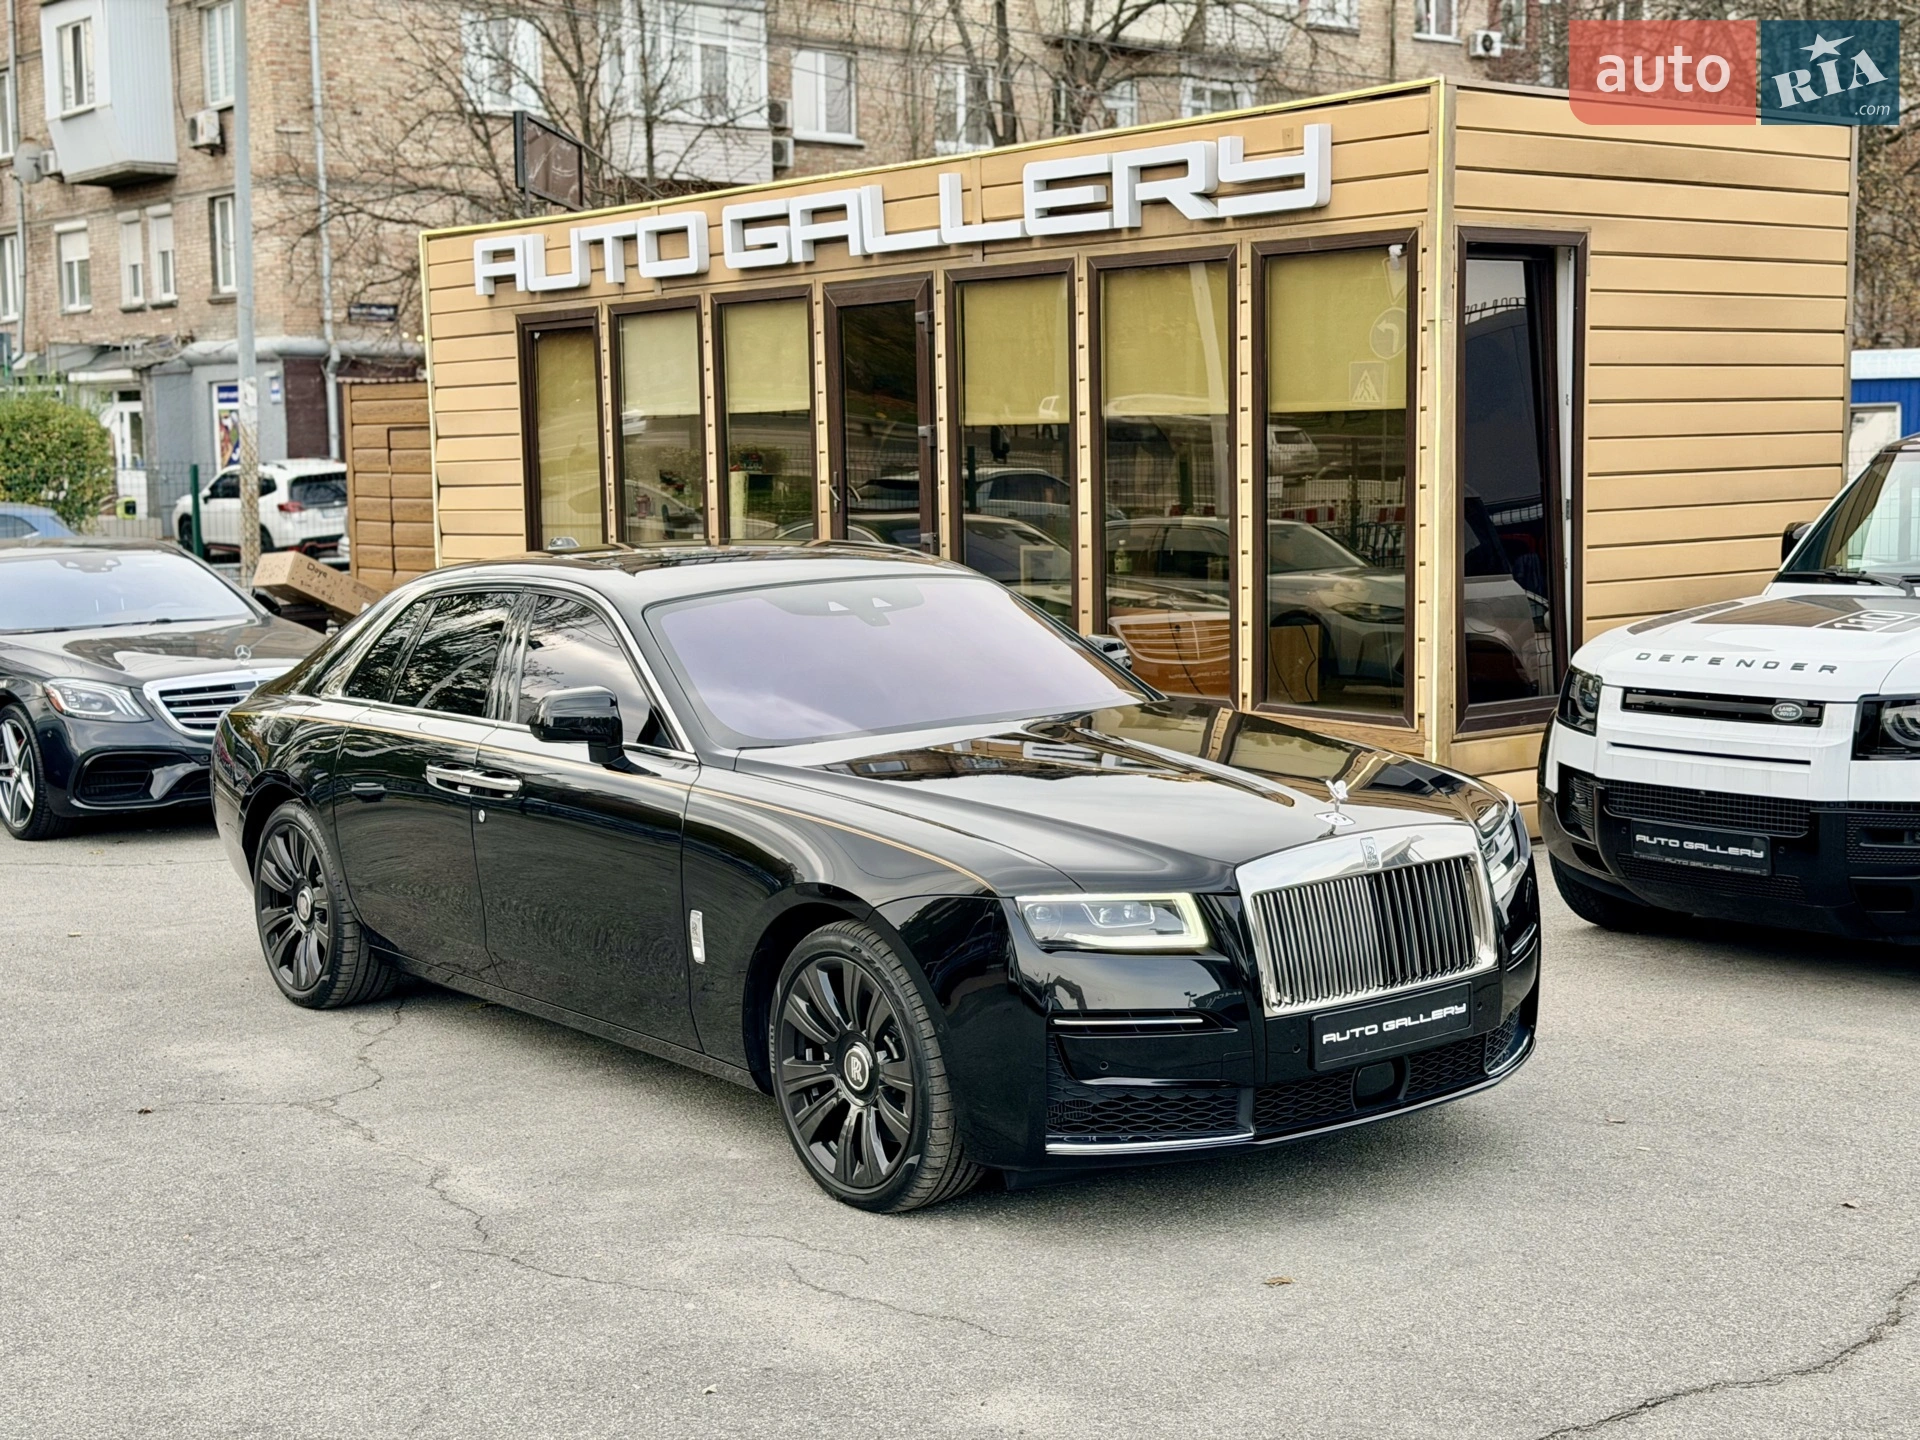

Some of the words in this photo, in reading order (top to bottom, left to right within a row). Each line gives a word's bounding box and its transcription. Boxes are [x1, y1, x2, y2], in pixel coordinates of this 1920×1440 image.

[473, 211, 709, 295] AUTO
[723, 123, 1331, 270] GALLERY
[1635, 652, 1837, 675] DEFENDER
[1636, 834, 1679, 847] AUTO
[1683, 841, 1764, 858] GALLERY
[1664, 858, 1689, 866] AUTO
[1690, 860, 1732, 871] GALLERY
[1322, 1024, 1378, 1044] AUTO
[1383, 1003, 1466, 1032] GALLERY
